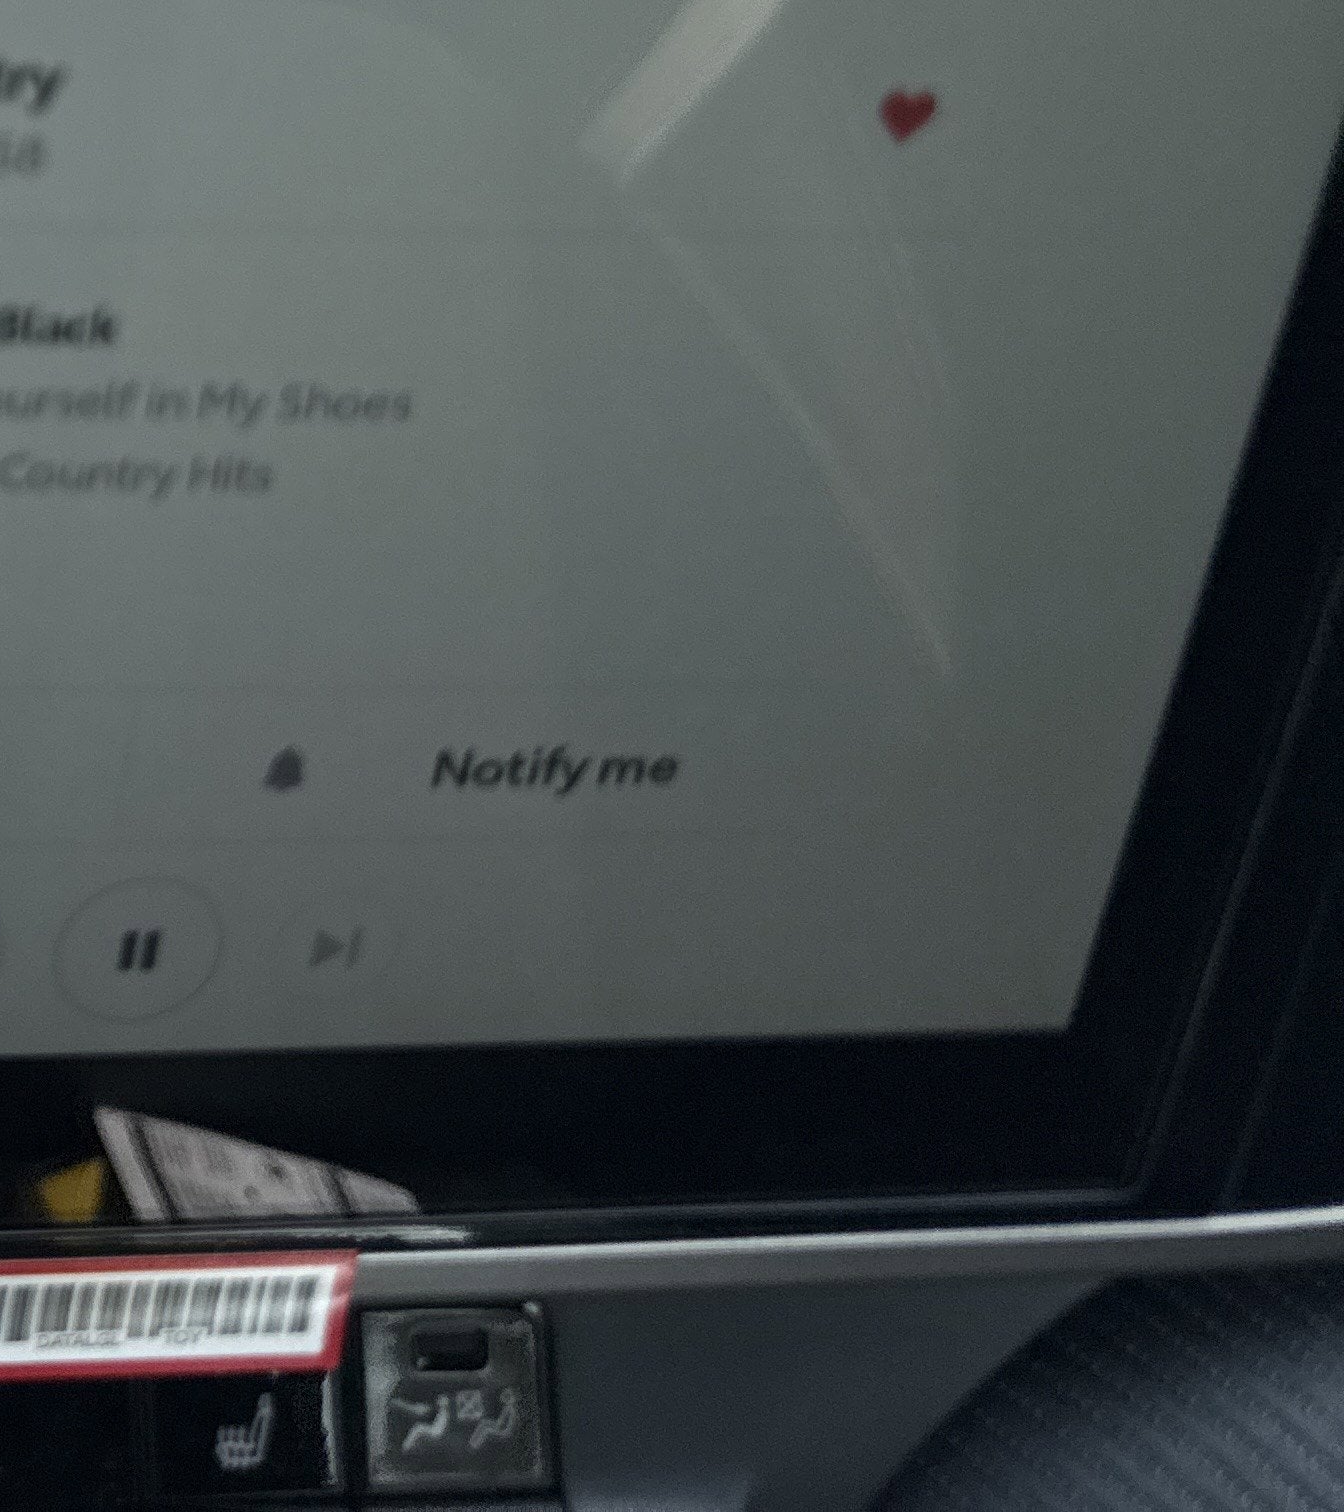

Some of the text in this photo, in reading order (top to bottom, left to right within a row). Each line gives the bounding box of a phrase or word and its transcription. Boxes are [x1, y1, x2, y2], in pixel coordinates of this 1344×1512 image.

[146, 382, 190, 422] in
[198, 382, 267, 430] My
[278, 384, 412, 426] Shoes
[187, 454, 273, 494] Hits
[432, 744, 680, 796] Notify me
